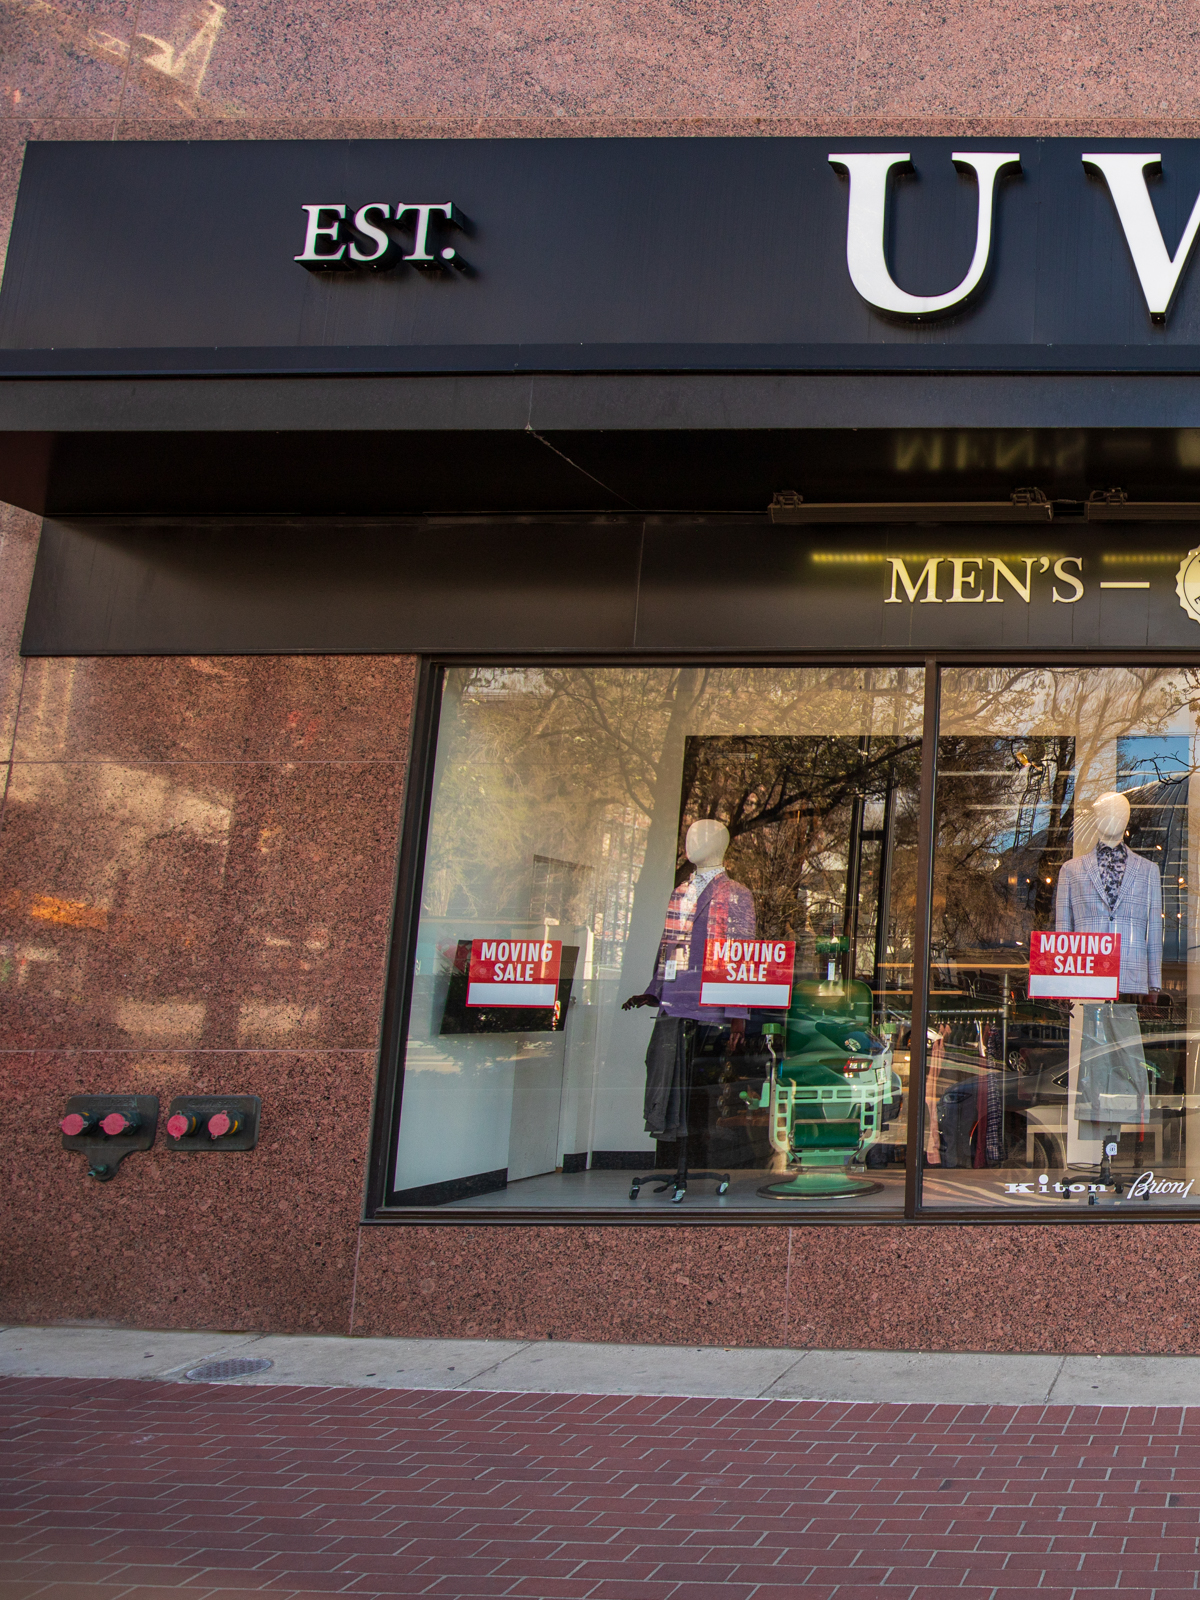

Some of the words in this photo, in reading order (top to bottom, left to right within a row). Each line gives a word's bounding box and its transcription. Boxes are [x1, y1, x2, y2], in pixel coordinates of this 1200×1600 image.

[293, 201, 456, 263] EST.
[884, 557, 1085, 604] MEN'S
[480, 942, 554, 962] MOVING
[712, 943, 787, 963] MOVING
[1039, 934, 1113, 956] MOVING
[493, 963, 535, 982] SALE
[725, 963, 768, 982] SALE
[1053, 956, 1095, 974] SALE
[1004, 1174, 1108, 1194] Kiton
